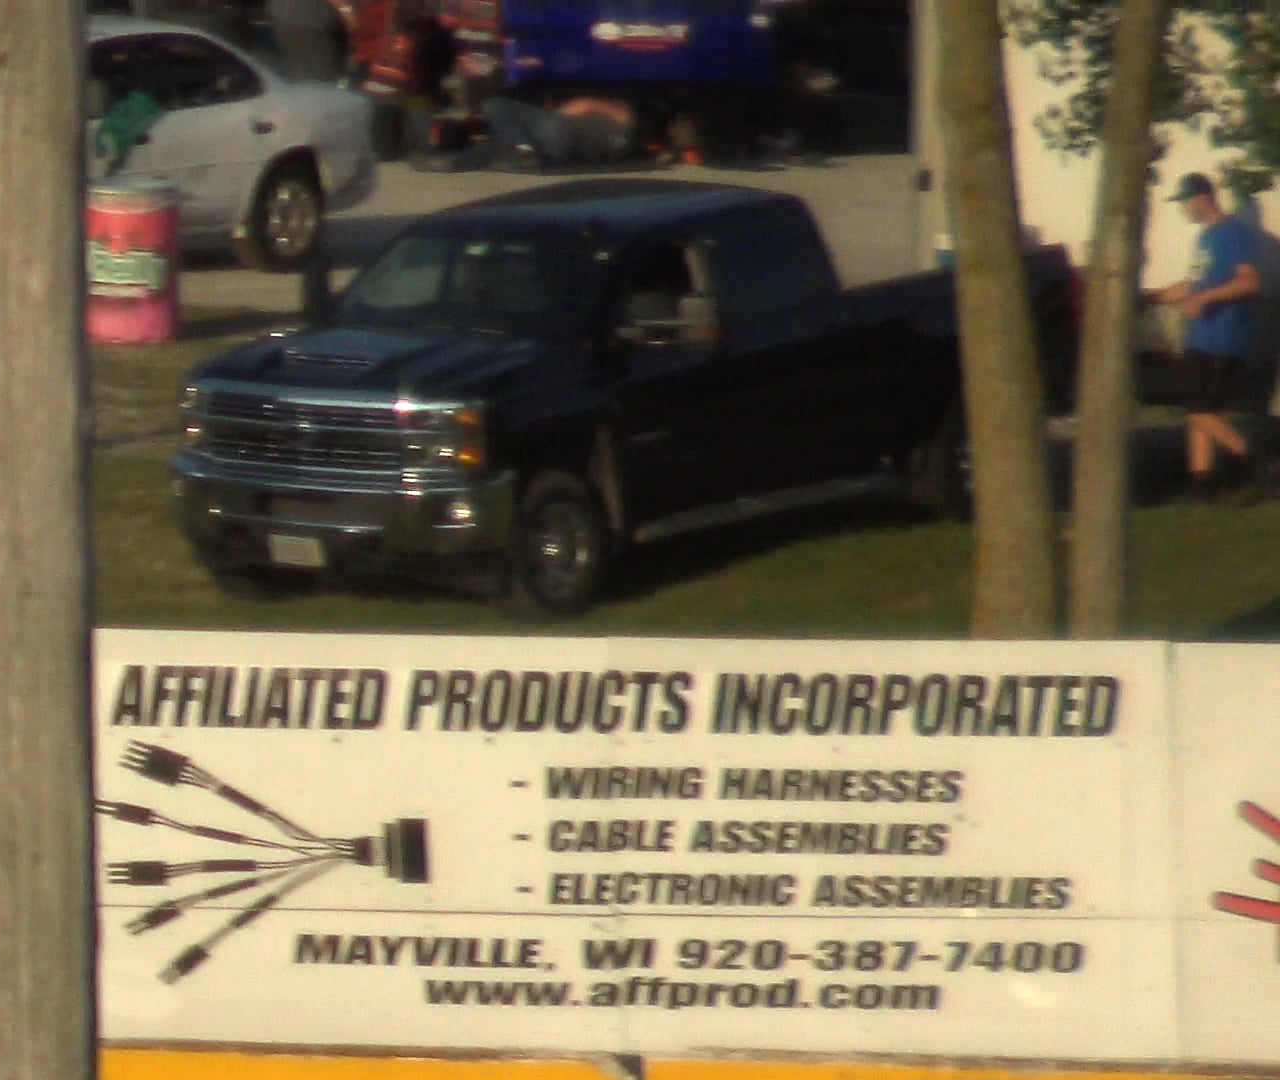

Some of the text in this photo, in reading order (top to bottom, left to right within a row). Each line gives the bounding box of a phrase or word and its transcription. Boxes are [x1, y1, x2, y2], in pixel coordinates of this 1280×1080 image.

[111, 664, 1121, 738] AFFILIATED PRODUCTS INCORPORATED
[545, 766, 965, 803] WIRING HARNESSES
[548, 820, 950, 856] CABLE ASSEMBLIES
[550, 872, 1072, 910] ELECTRONIC ASSEMBLIES
[293, 933, 1086, 974] MAYVILLE, WI 920-387-7400
[424, 975, 942, 1011] www.affprod.com
